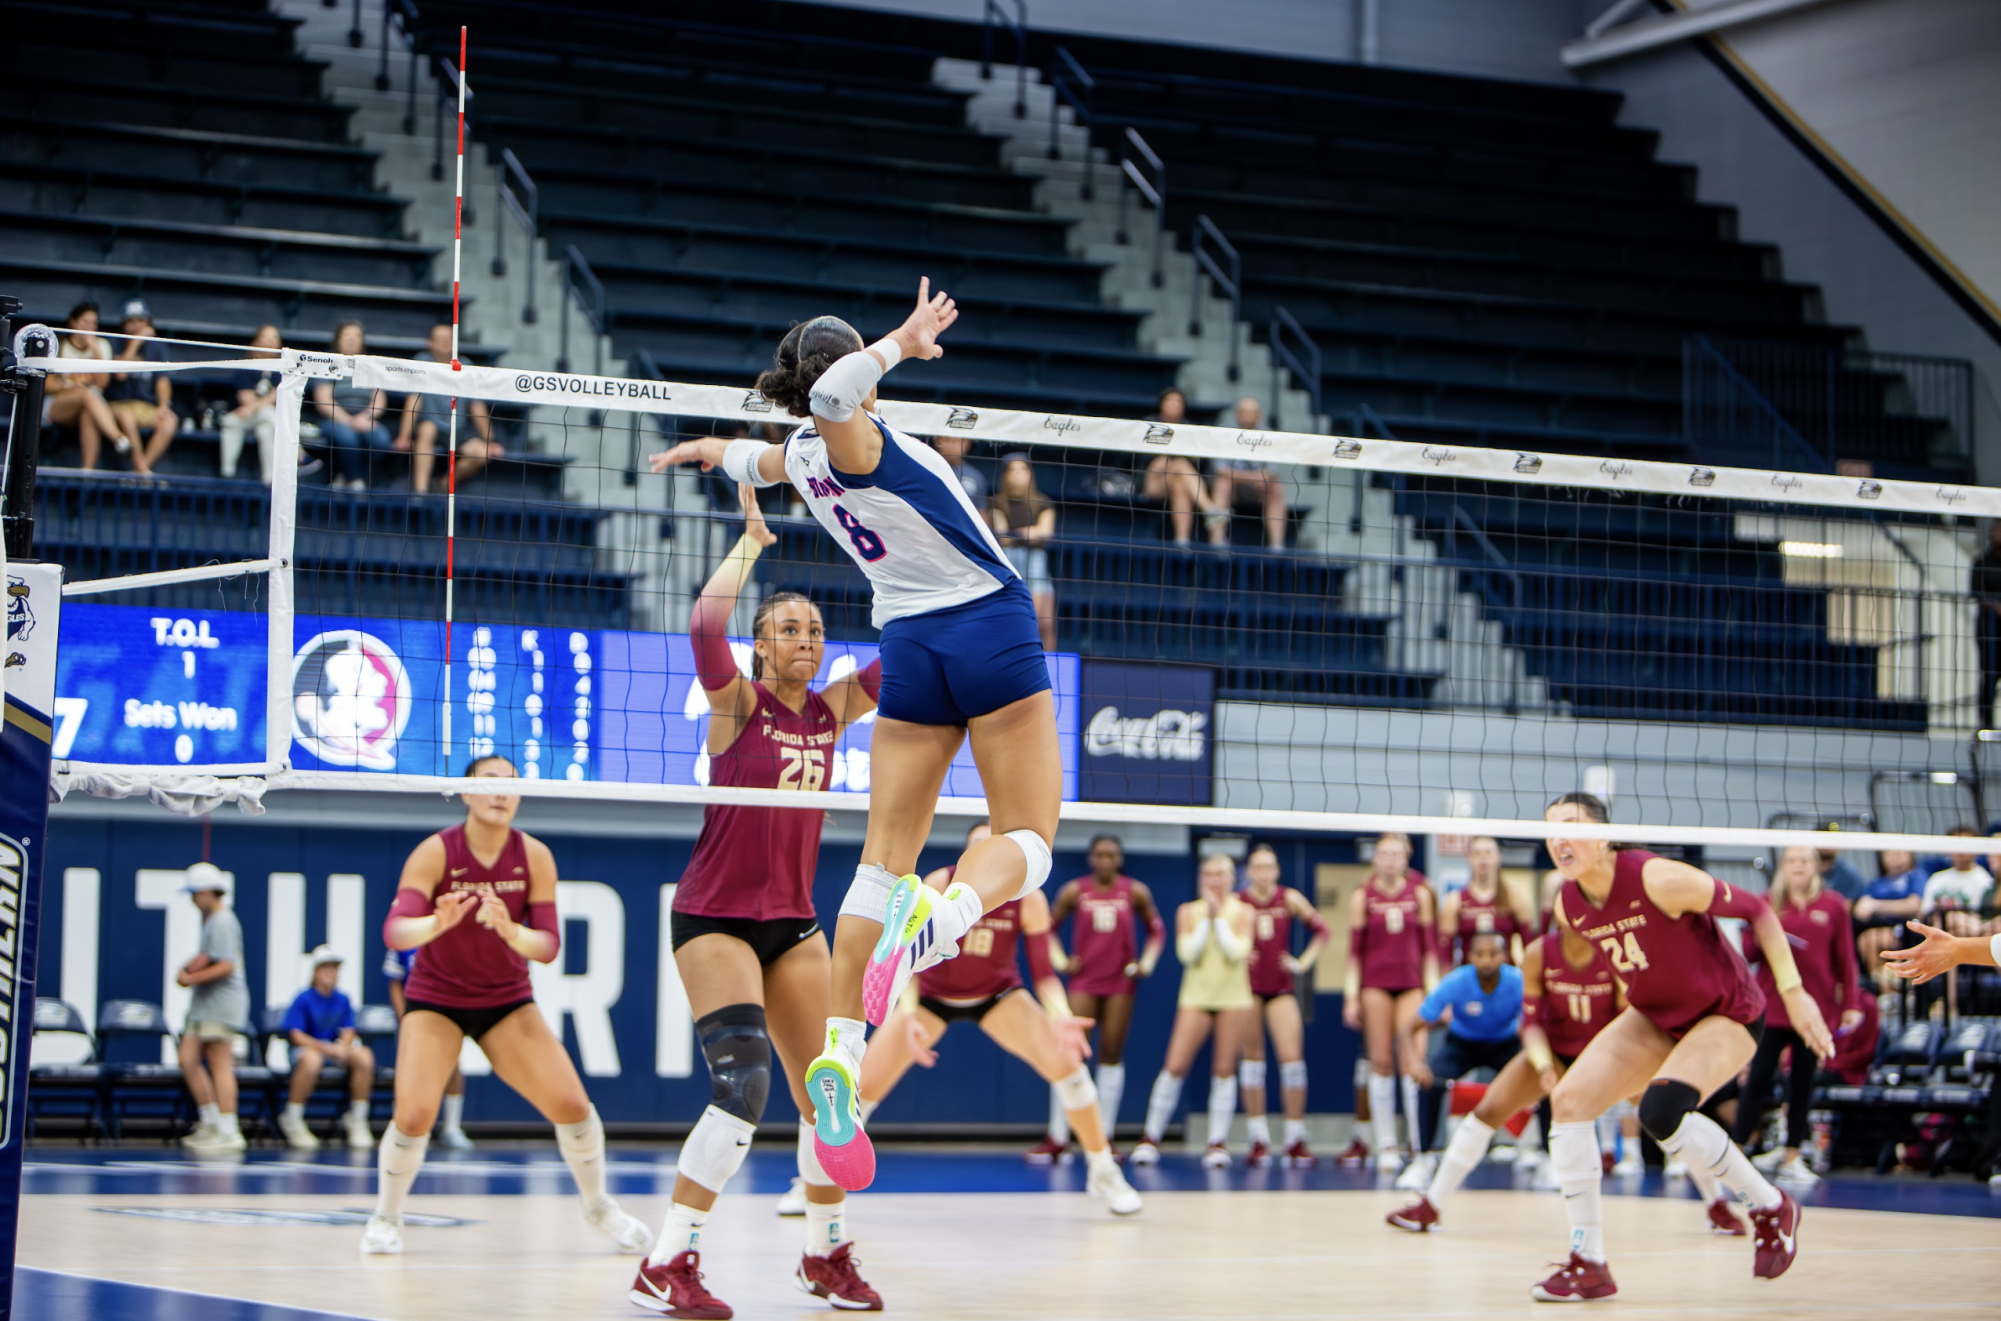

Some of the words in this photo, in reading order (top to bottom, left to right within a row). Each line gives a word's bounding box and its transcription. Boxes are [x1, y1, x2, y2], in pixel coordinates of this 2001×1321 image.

[307, 355, 333, 364] Senoh
[515, 374, 672, 400] @GSVOLLEYBALL
[1044, 415, 1081, 437] Eagles
[1236, 431, 1273, 452] Eagles
[1421, 446, 1457, 466] Eagles
[1600, 459, 1633, 480] Eagles
[1770, 472, 1803, 493] Eagles
[1936, 485, 1967, 505] Eagles
[832, 504, 888, 563] 8
[182, 651, 195, 679] 1
[124, 698, 177, 728] Sets
[179, 701, 237, 731] Won
[175, 734, 193, 763] 0
[777, 746, 825, 791] 26
[1616, 914, 1647, 932] STATE
[1600, 931, 1650, 973] 24
[1567, 993, 1592, 1024] 11
